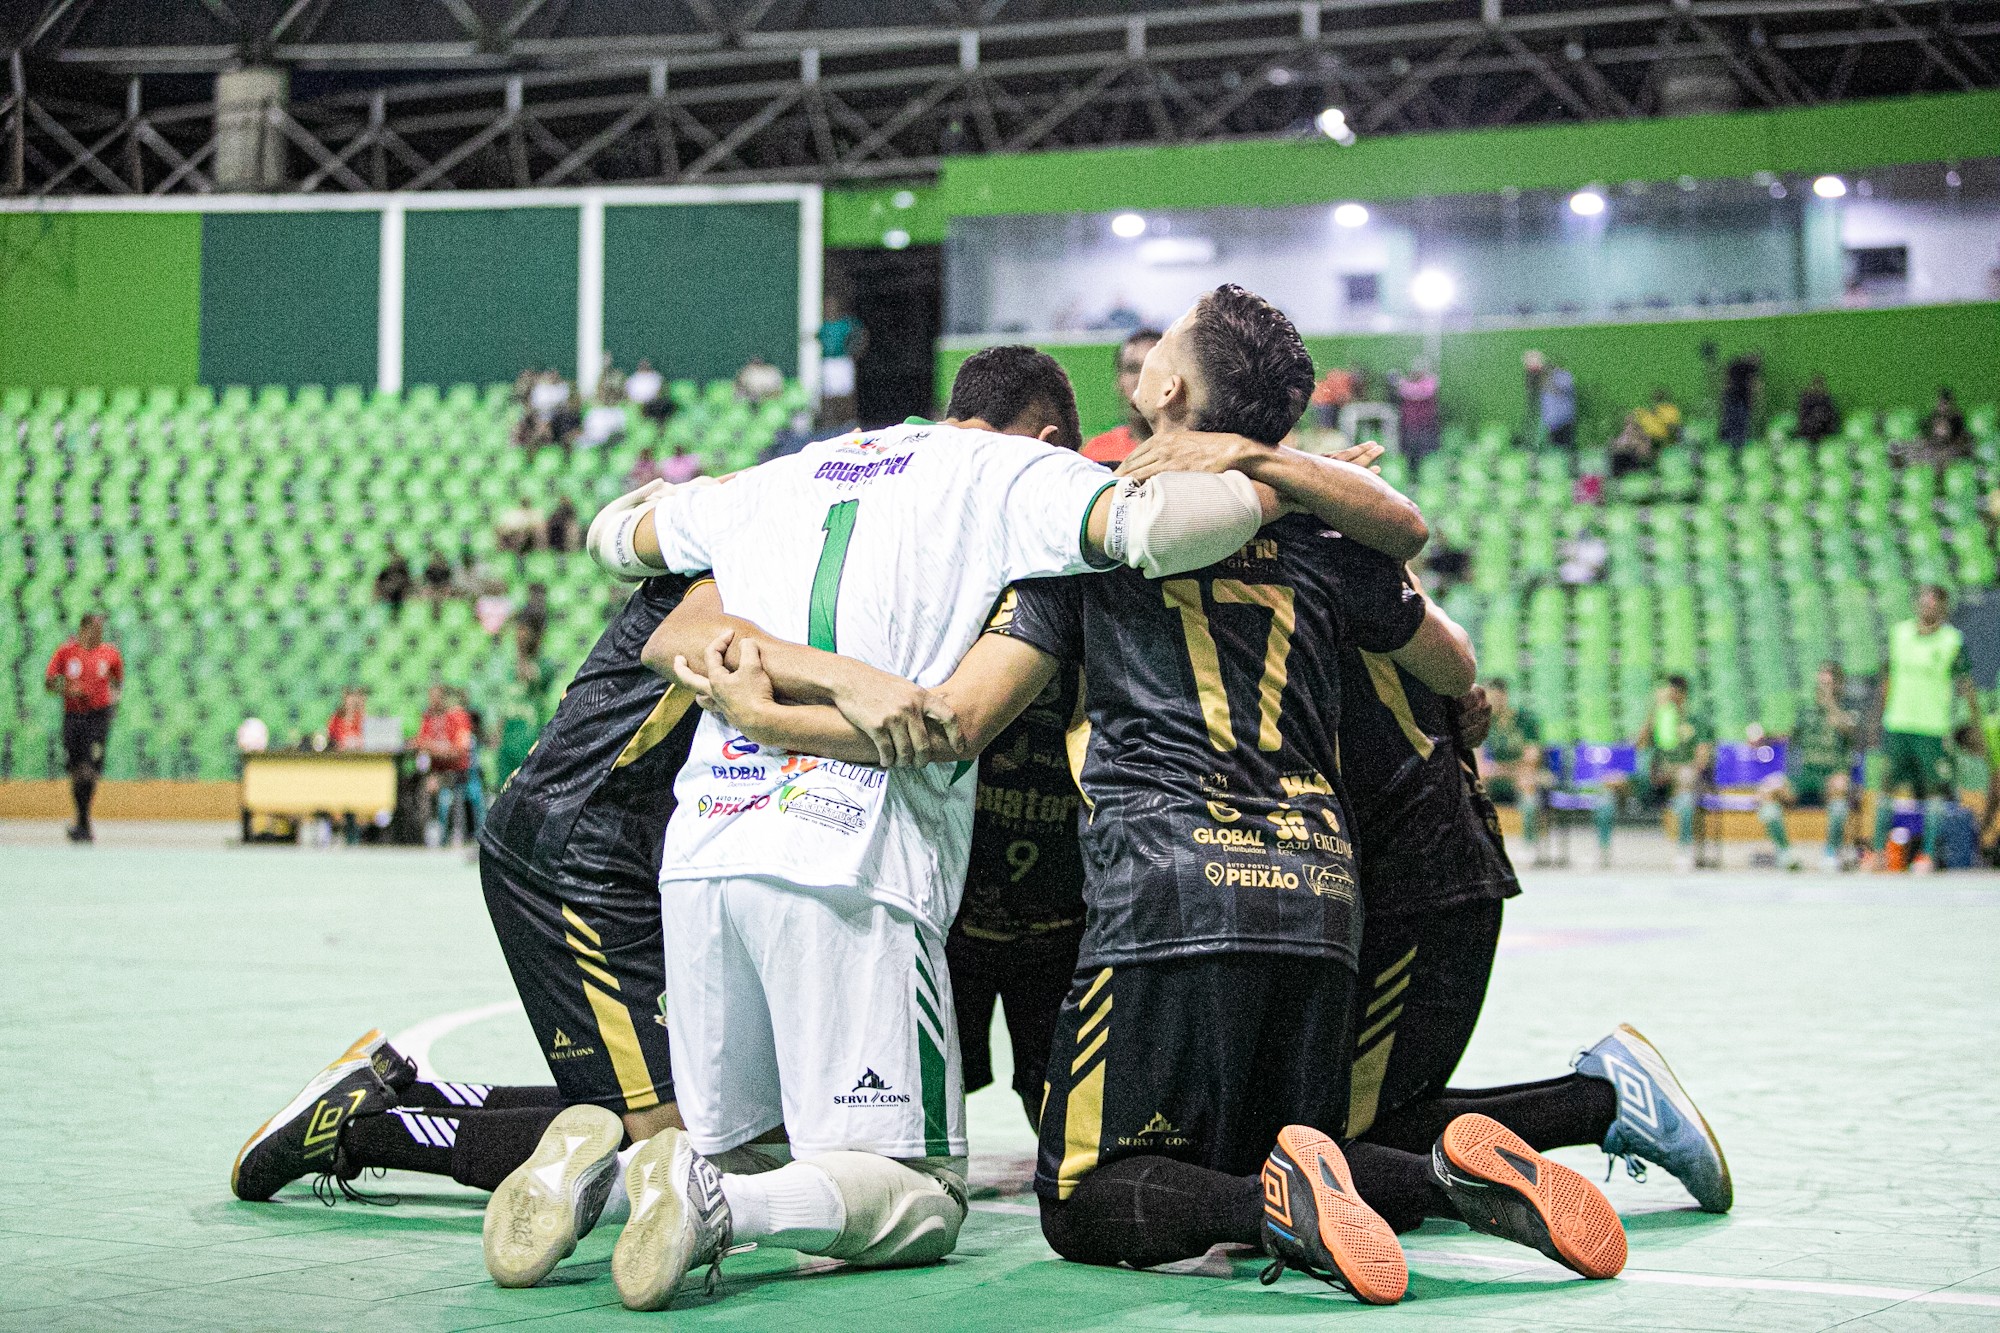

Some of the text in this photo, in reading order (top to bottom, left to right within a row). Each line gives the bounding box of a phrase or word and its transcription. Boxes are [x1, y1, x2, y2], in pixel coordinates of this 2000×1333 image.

[807, 498, 860, 654] 1
[1161, 577, 1296, 753] 17
[711, 765, 767, 781] GLOBAL
[1192, 827, 1265, 847] GLOBAL
[1276, 840, 1311, 851] CAJU
[1222, 844, 1267, 855] Distribuidora
[1005, 839, 1040, 883] 9
[1226, 865, 1299, 890] PEIXÃO
[834, 1095, 910, 1104] SERVI CONS
[1164, 1137, 1194, 1146] CON
